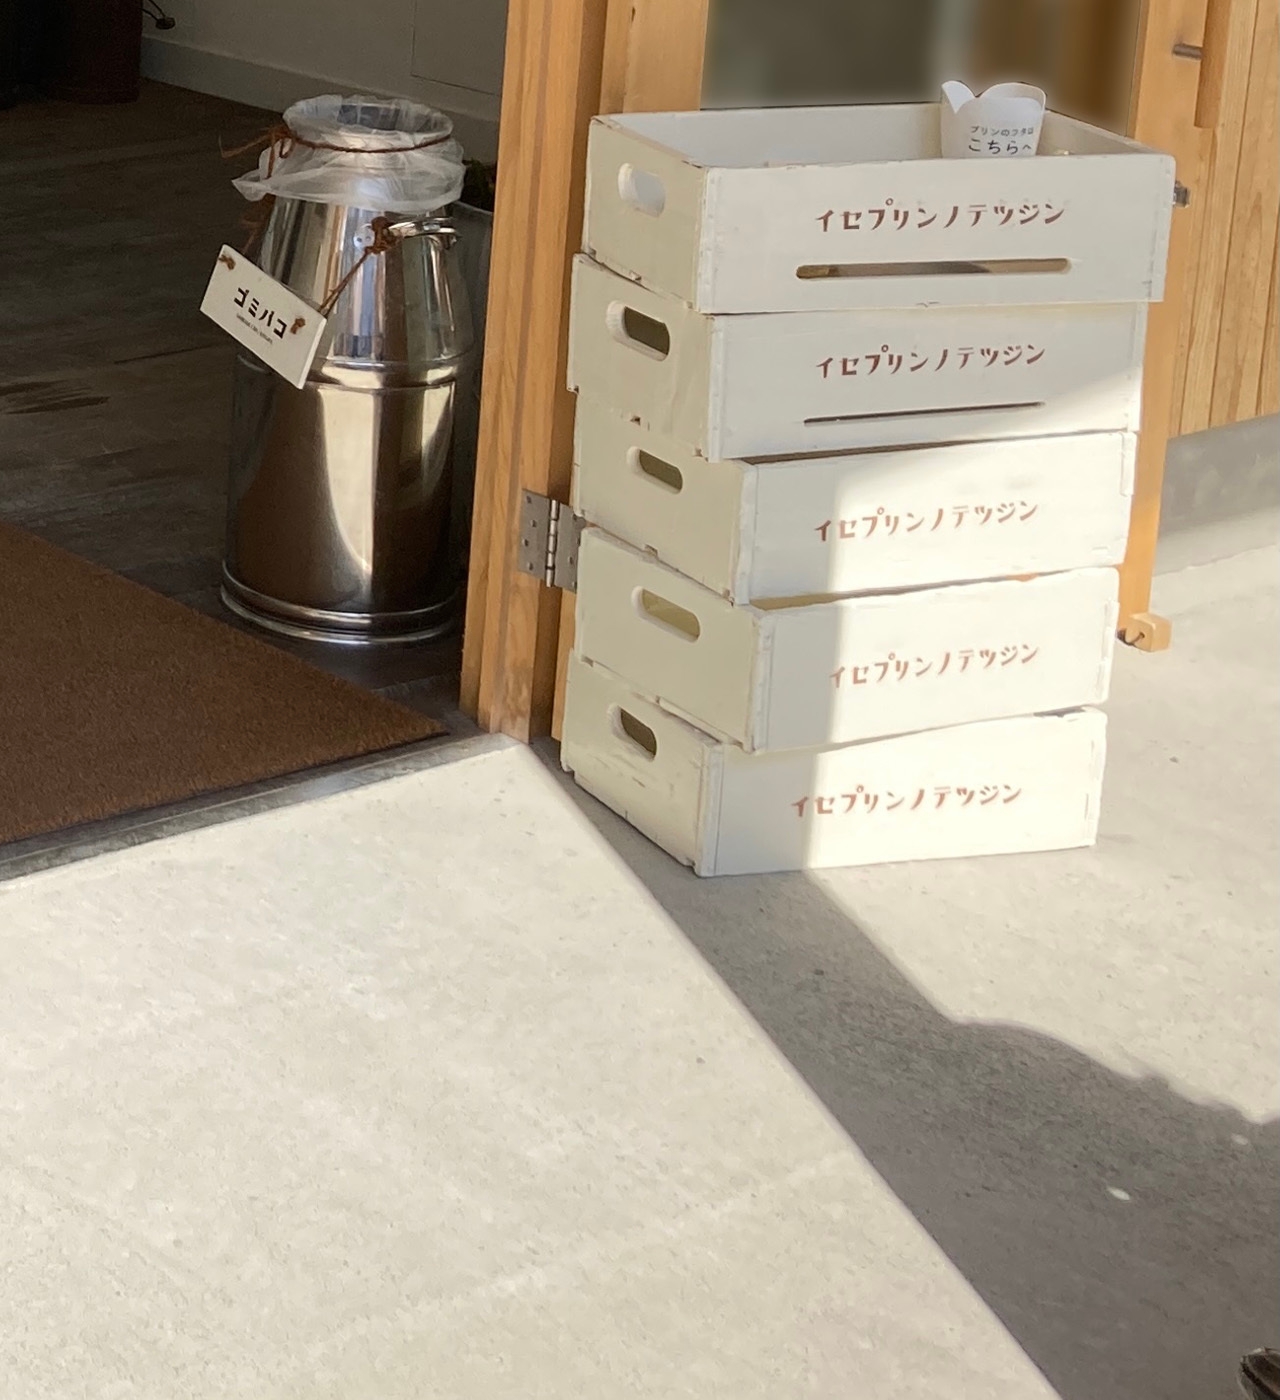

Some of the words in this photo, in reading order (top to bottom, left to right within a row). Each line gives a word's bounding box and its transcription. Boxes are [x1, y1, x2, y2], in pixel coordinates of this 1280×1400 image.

[968, 138, 1032, 155] こちらへ
[815, 197, 1065, 233] イセプリンノテツジン
[233, 287, 288, 340] ゴミハコ
[816, 345, 1046, 379] イセプリンノテツジン
[814, 500, 1039, 543] イセプリンノテツジン
[829, 642, 1041, 689] イセプリンノテツジン
[790, 782, 1025, 819] イセプリンノテツジン
